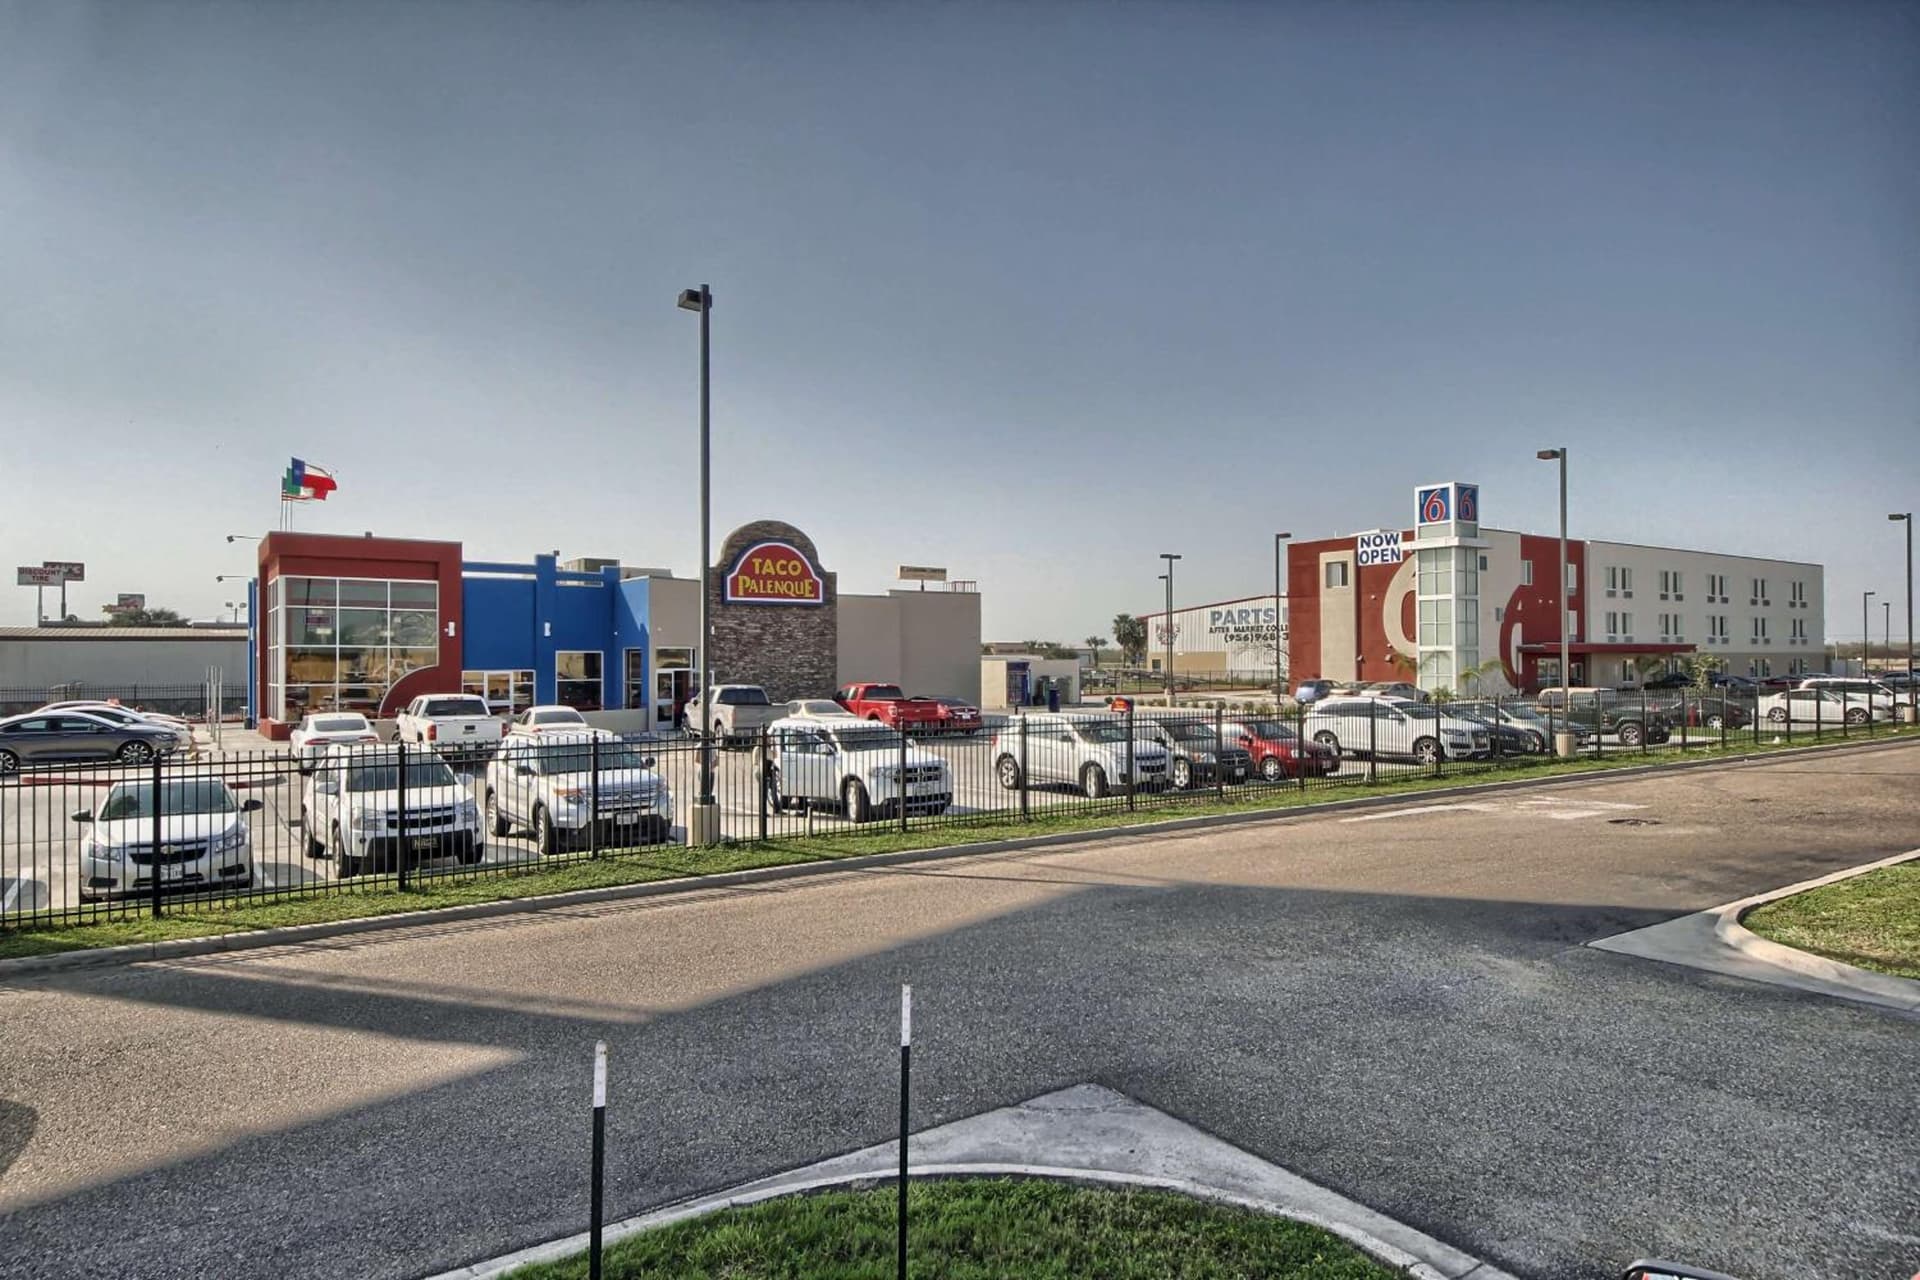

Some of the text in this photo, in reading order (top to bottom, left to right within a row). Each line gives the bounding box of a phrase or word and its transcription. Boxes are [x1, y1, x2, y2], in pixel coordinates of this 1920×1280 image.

[1423, 489, 1446, 522] 6
[1460, 488, 1474, 520] 6
[1360, 533, 1399, 548] NOW
[1359, 548, 1401, 565] OPEN
[18, 567, 60, 576] DISCOUNT
[752, 558, 802, 576] TACO
[738, 575, 815, 597] PALENQUE
[1210, 608, 1276, 625] PARTS
[1209, 626, 1230, 634] AFTER
[1234, 625, 1264, 633] MARKET
